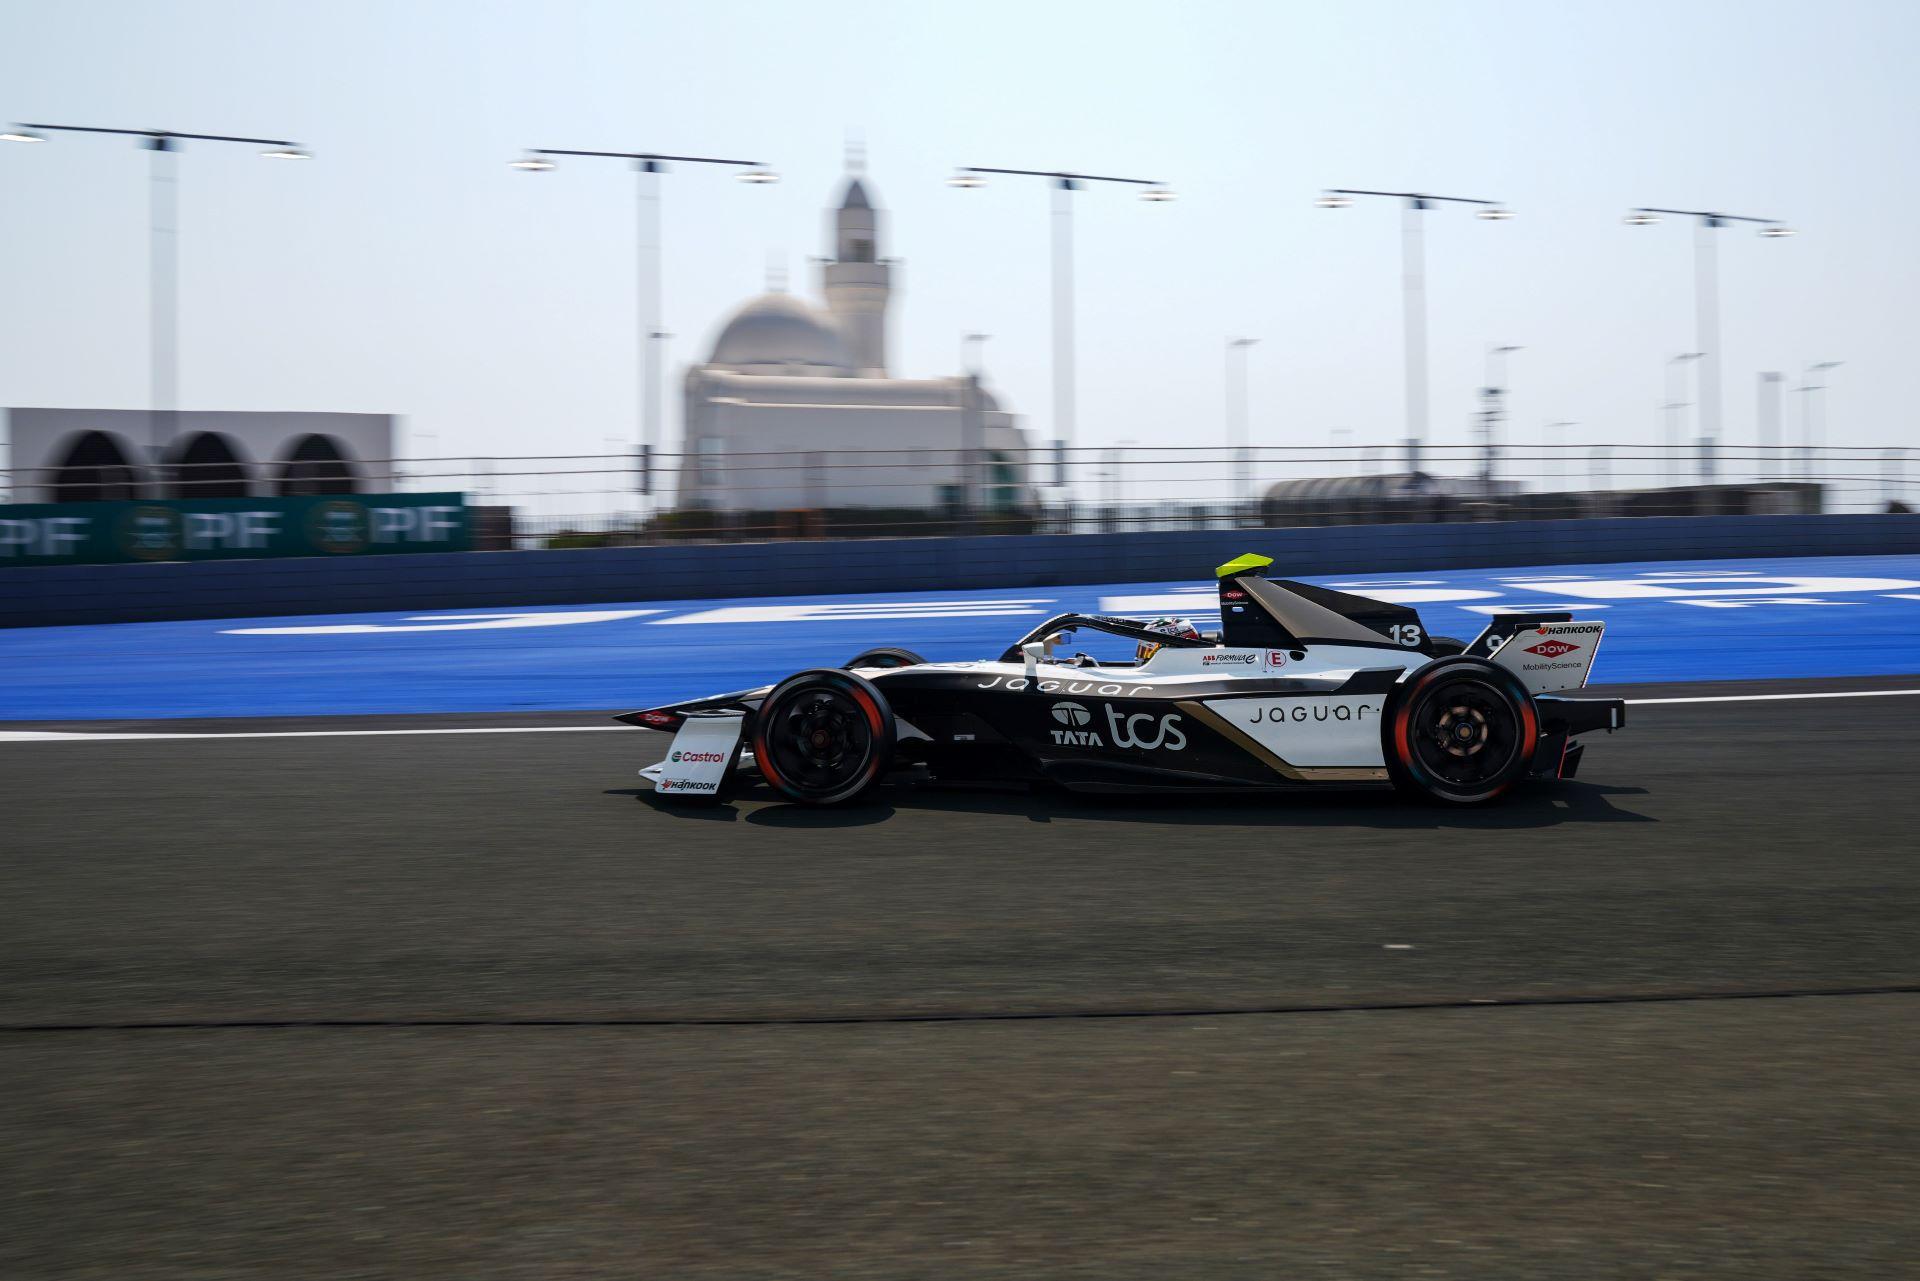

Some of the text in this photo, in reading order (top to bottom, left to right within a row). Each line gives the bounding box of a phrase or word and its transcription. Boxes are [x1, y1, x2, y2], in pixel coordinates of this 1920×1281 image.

[1389, 624, 1421, 647] 13
[1522, 662, 1582, 671] MobilityScience
[1104, 702, 1187, 750] tcs
[1050, 730, 1104, 747] TATA
[682, 751, 725, 763] Castrol
